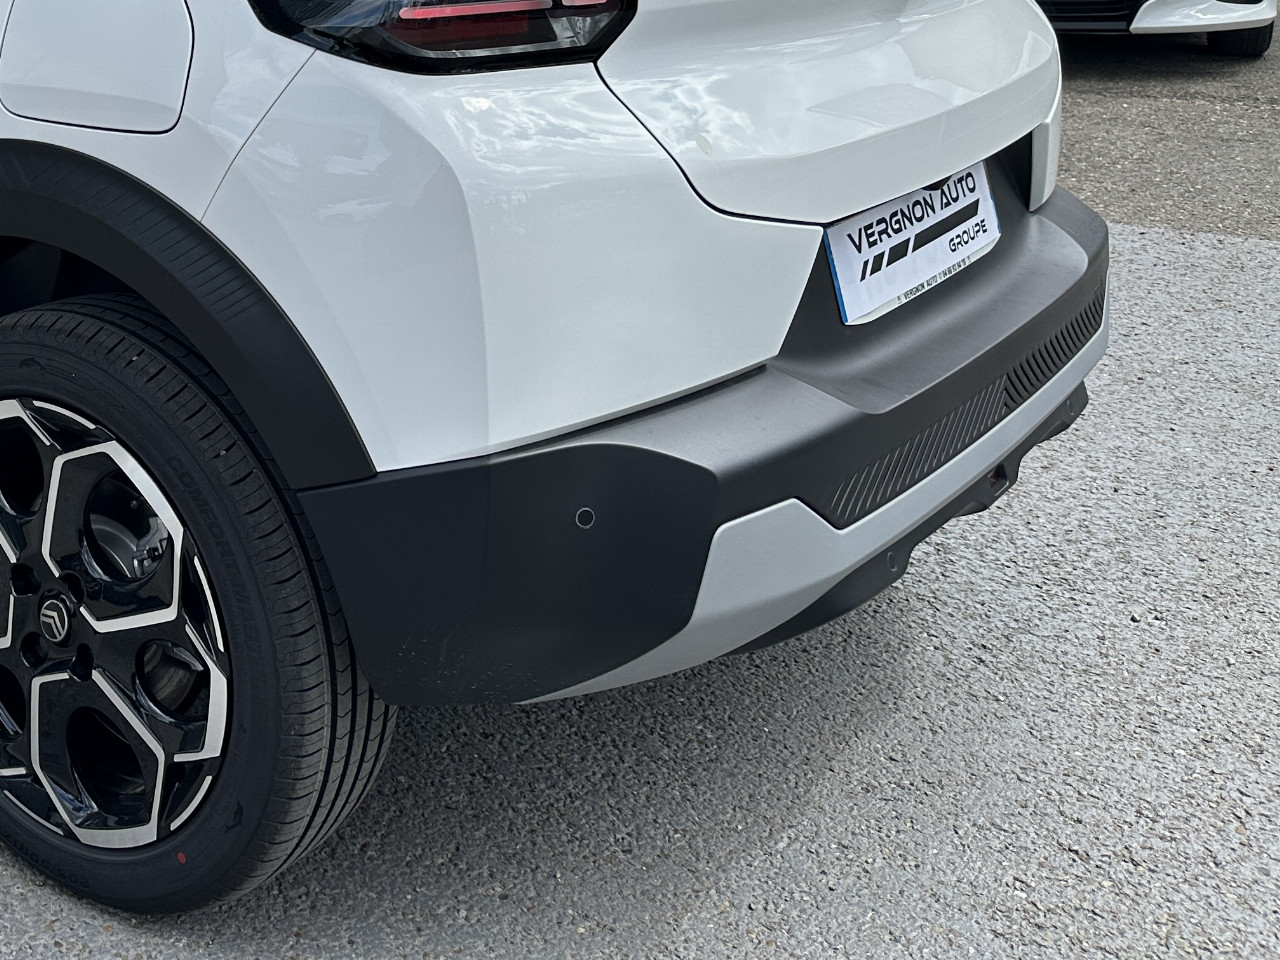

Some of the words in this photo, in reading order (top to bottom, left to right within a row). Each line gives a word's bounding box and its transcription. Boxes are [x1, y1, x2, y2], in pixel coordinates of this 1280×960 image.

[846, 193, 936, 254] VERGNON
[940, 171, 976, 211] AUTO
[948, 218, 988, 253] GROUPE
